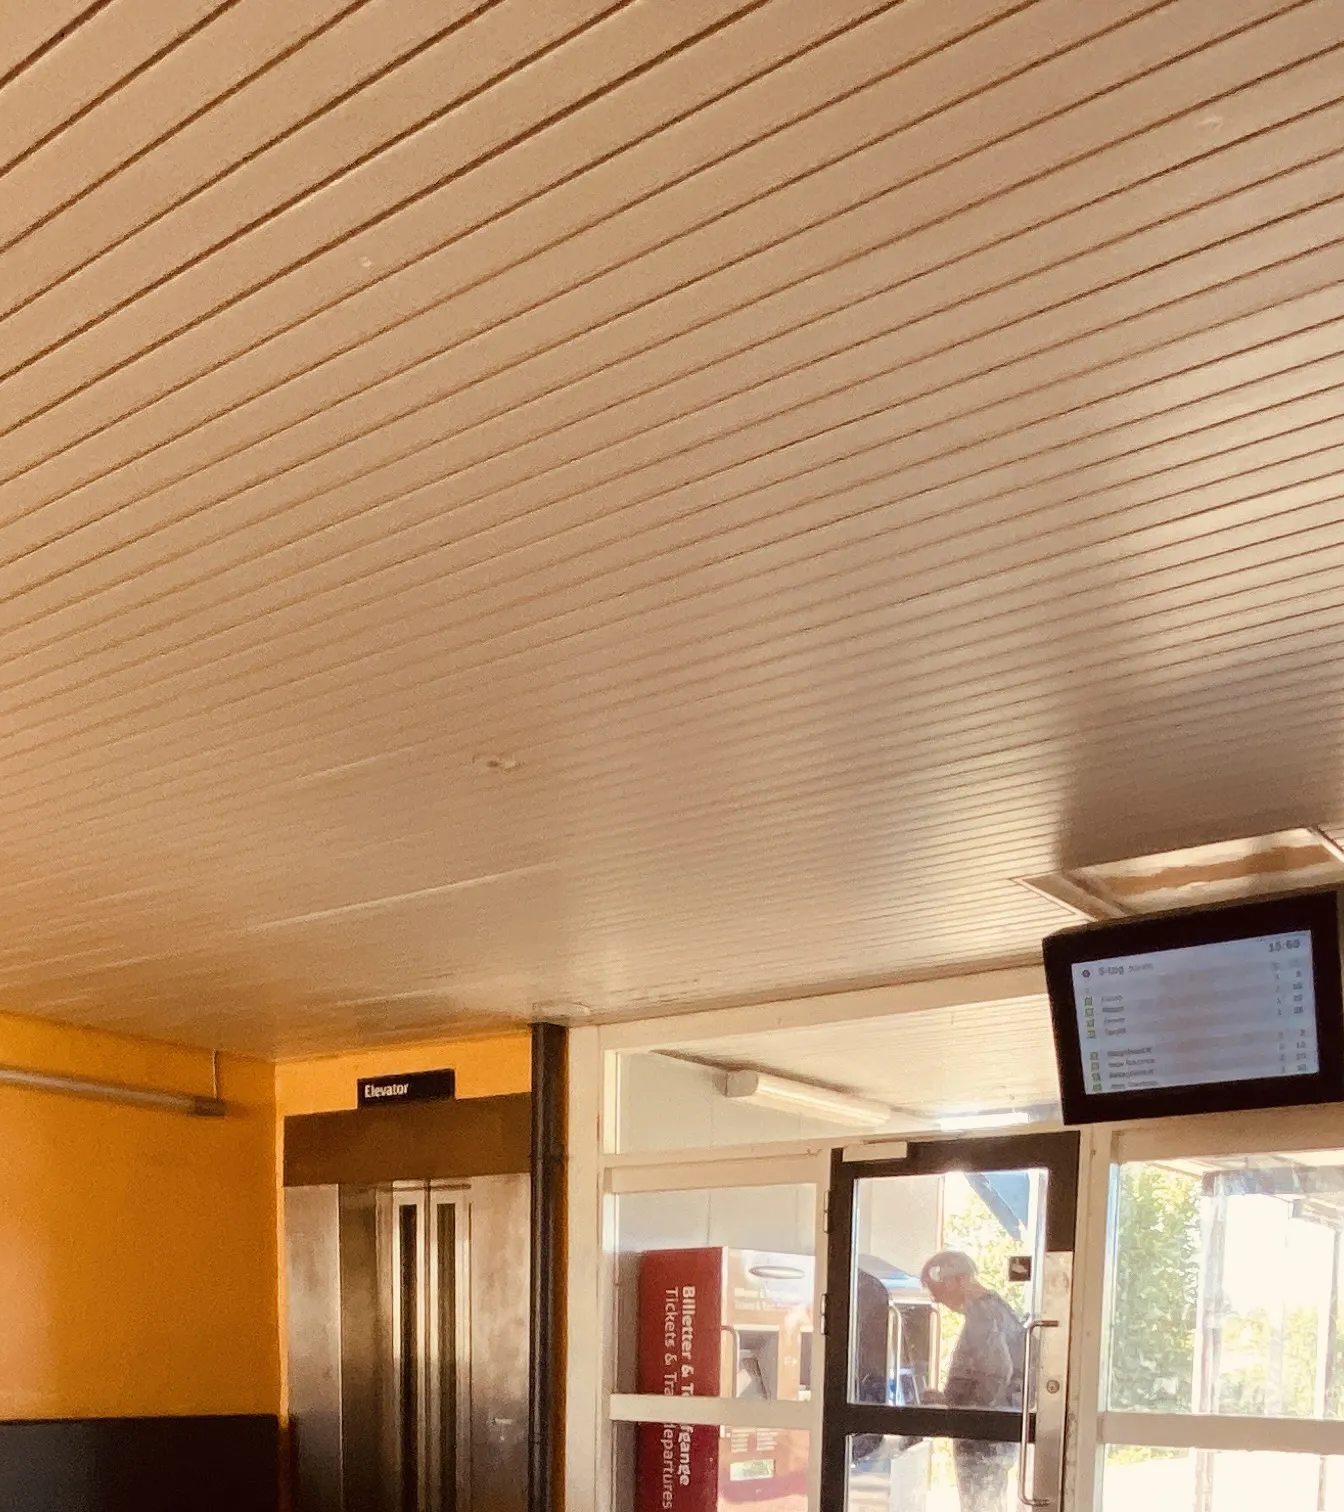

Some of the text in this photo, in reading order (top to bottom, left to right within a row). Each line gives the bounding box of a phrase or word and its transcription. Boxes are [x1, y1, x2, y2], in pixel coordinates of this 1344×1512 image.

[364, 1082, 409, 1098] Elevator
[664, 1286, 679, 1347] Tickets
[681, 1286, 696, 1360] Billetter
[664, 1352, 677, 1366] &
[681, 1363, 694, 1378] &
[664, 1372, 677, 1396] Tra
